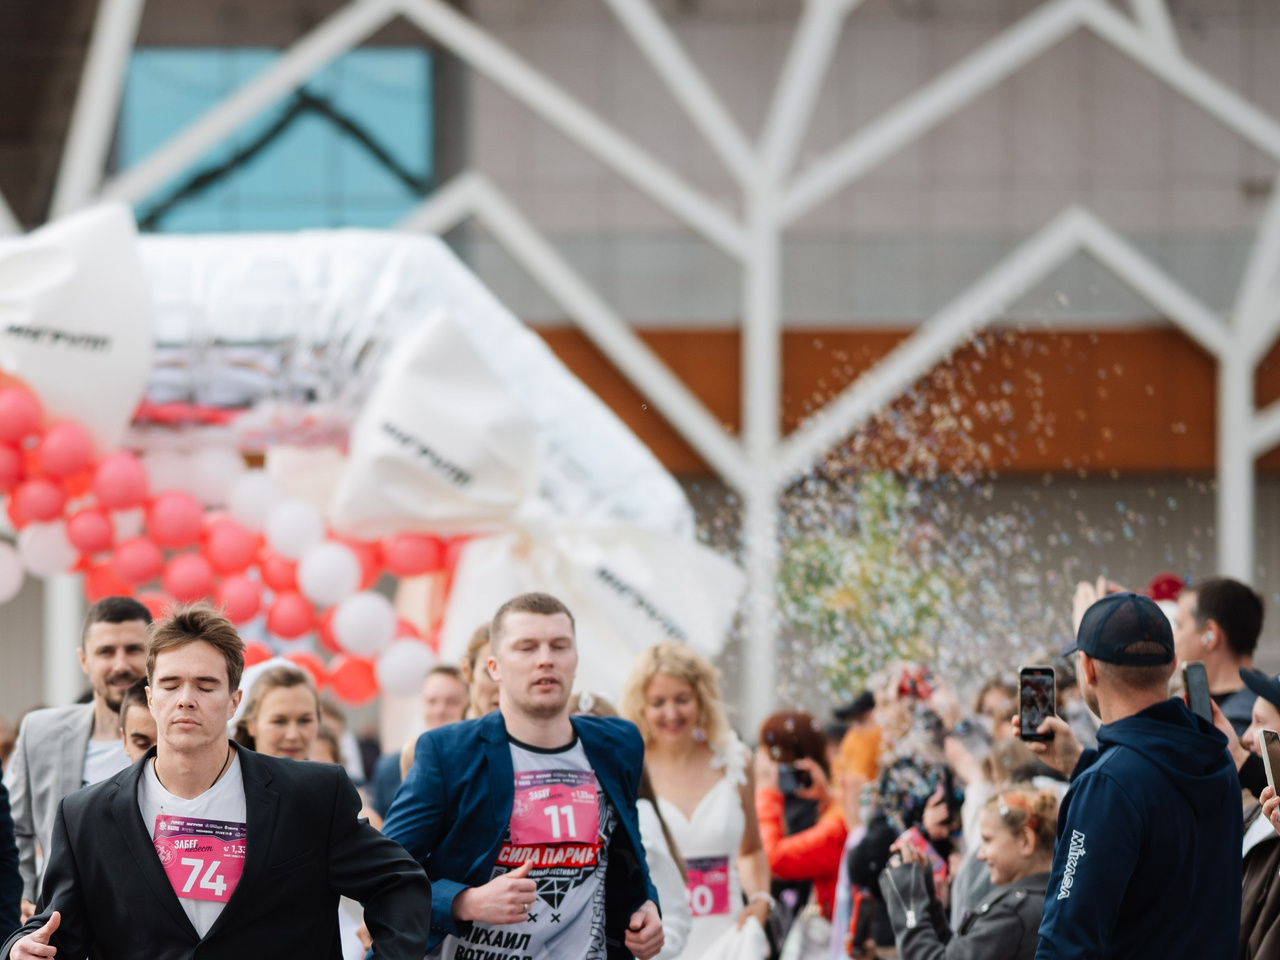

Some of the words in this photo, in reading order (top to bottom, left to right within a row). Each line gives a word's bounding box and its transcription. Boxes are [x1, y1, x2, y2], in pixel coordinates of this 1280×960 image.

[543, 804, 577, 839] 11
[174, 839, 199, 850] ЗАБЕГ
[498, 846, 540, 865] СИЛА
[181, 857, 228, 897] 74
[689, 884, 715, 916] 0
